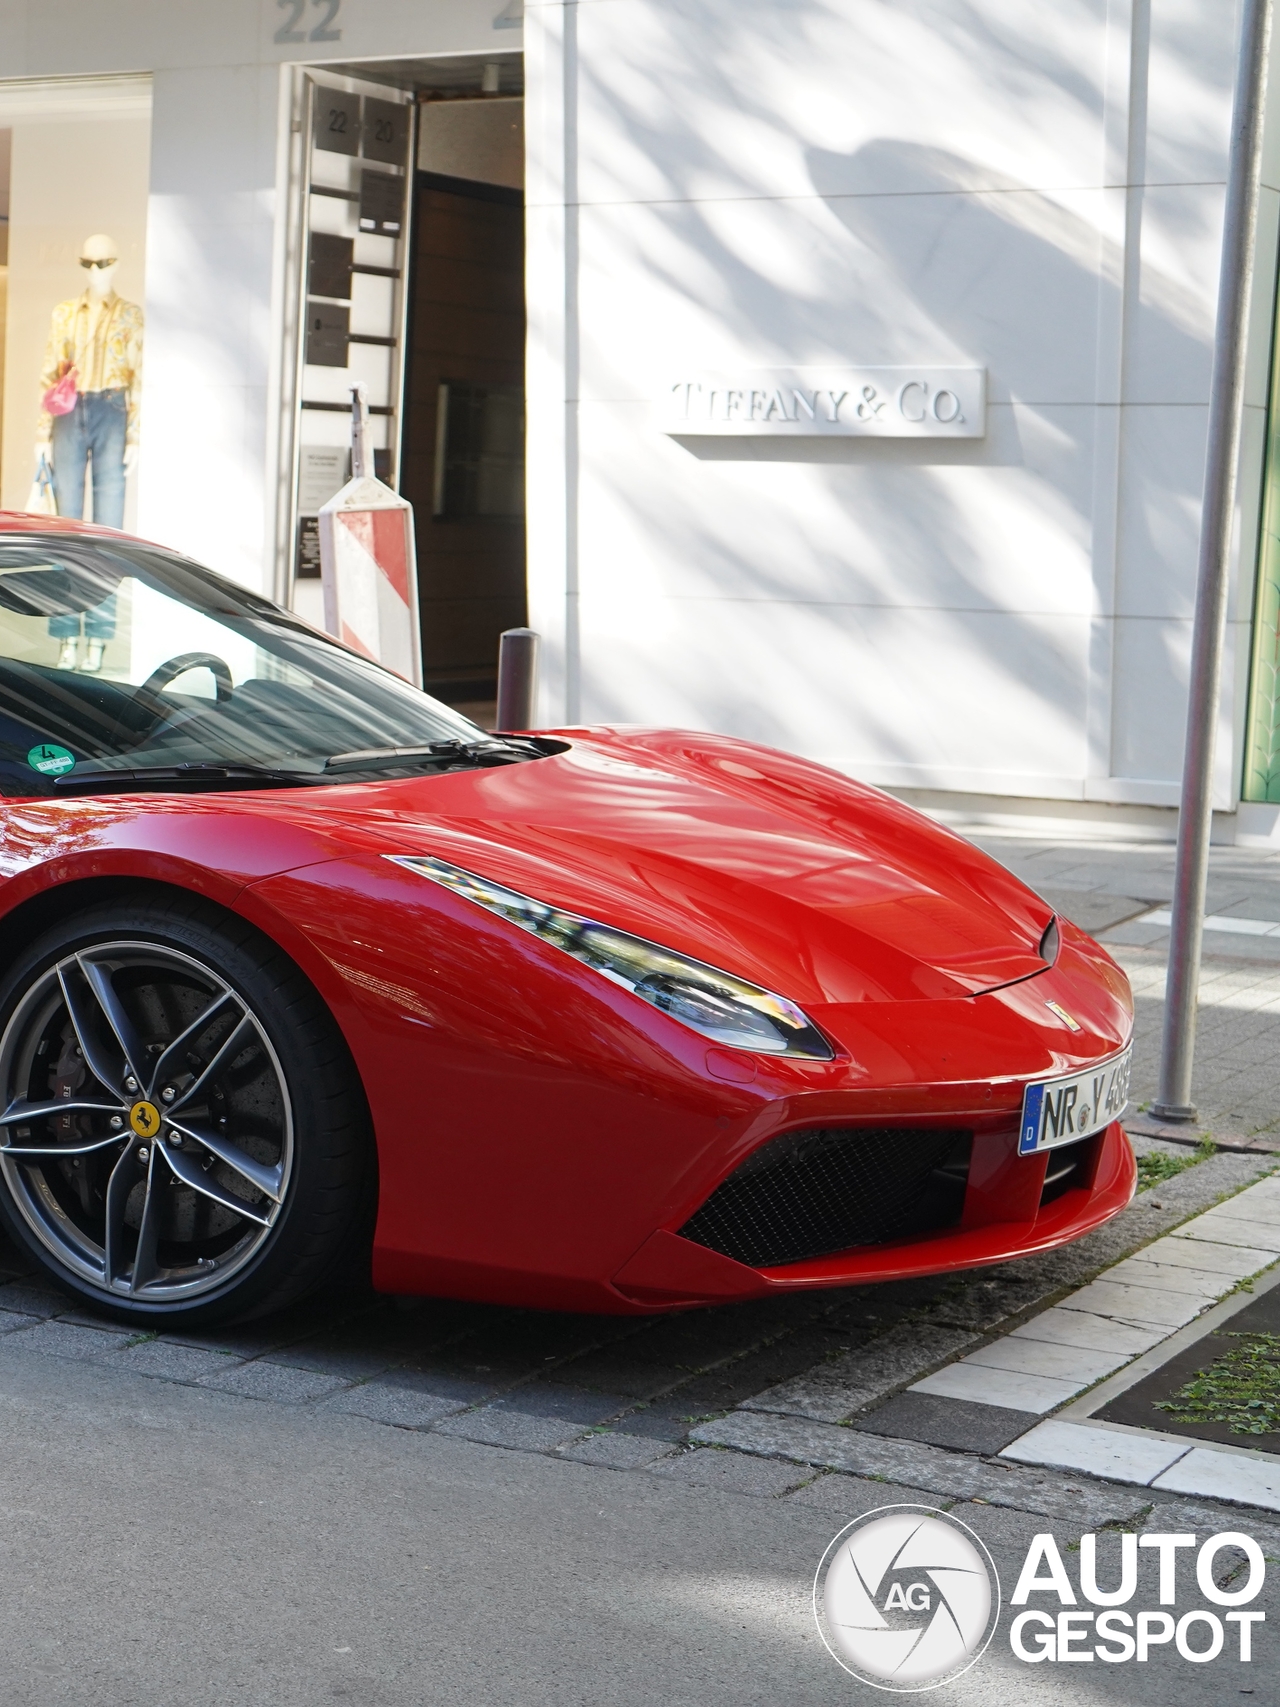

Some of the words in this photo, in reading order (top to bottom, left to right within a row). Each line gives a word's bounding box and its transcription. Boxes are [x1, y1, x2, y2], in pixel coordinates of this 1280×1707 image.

[273, 0, 342, 44] 22
[328, 109, 348, 134] 22
[856, 385, 886, 422] &
[41, 745, 55, 759] 4
[168, 924, 229, 958] MICHELIN
[1040, 1083, 1078, 1140] NR
[1093, 1073, 1106, 1125] Y
[1026, 1127, 1034, 1141] D
